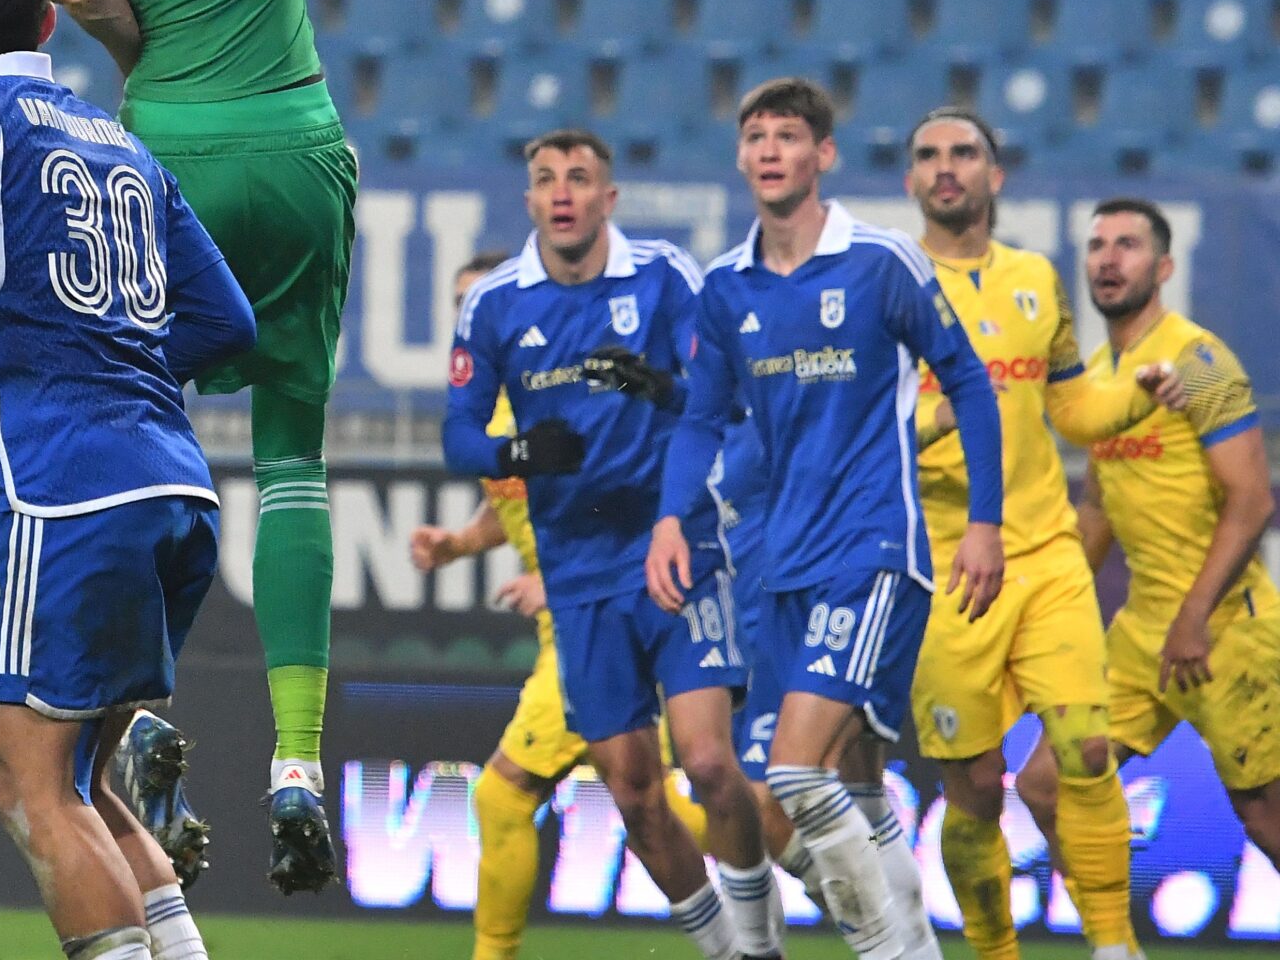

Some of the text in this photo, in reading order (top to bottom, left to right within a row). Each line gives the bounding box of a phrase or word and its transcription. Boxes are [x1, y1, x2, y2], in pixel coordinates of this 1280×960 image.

[41, 149, 168, 331] 30
[681, 597, 724, 643] 18
[805, 602, 856, 651] 99
